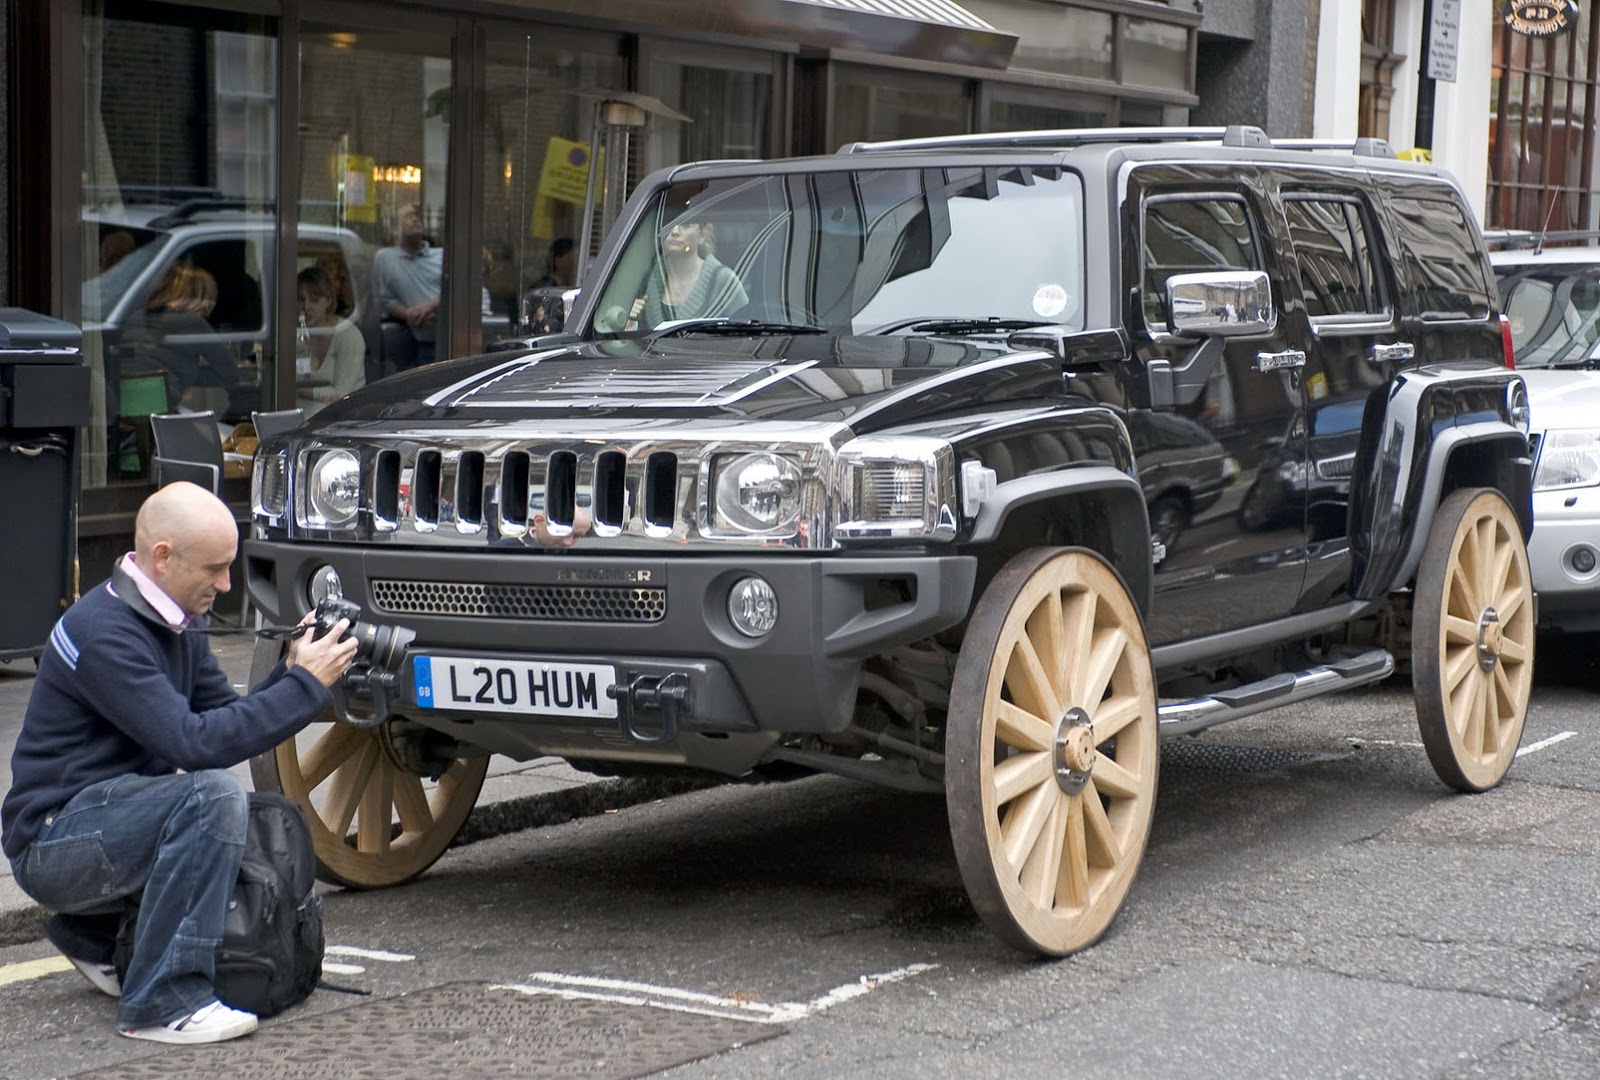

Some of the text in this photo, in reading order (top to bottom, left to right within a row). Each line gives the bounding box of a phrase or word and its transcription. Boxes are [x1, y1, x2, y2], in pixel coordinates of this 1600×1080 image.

[1511, 20, 1559, 35] SHEPPARD
[418, 686, 431, 698] GB
[449, 665, 598, 710] L20 HUM
